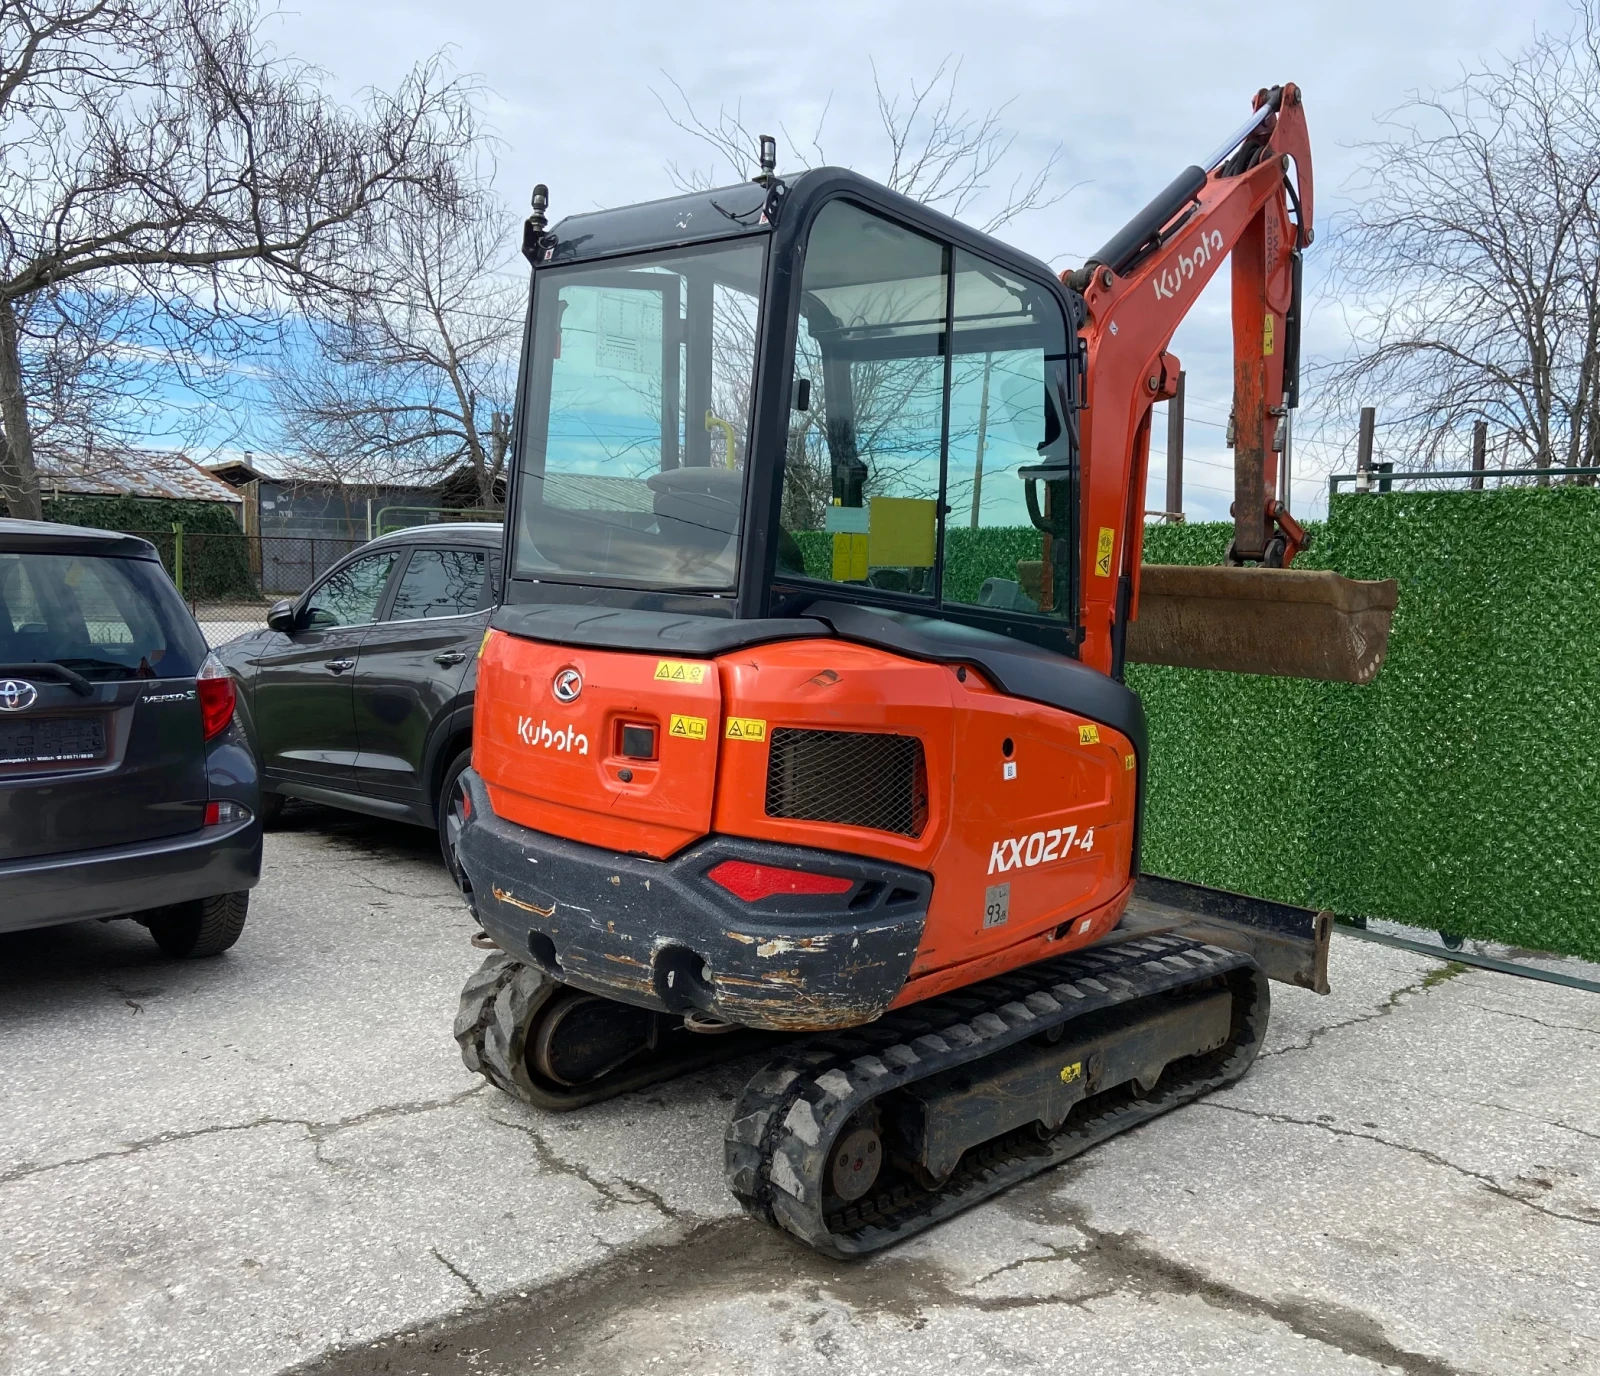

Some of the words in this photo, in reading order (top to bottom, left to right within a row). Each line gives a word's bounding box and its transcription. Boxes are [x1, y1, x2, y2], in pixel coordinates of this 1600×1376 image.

[1152, 228, 1224, 301] Kubota
[517, 715, 589, 755] Kubota
[987, 825, 1094, 875] KX027-4
